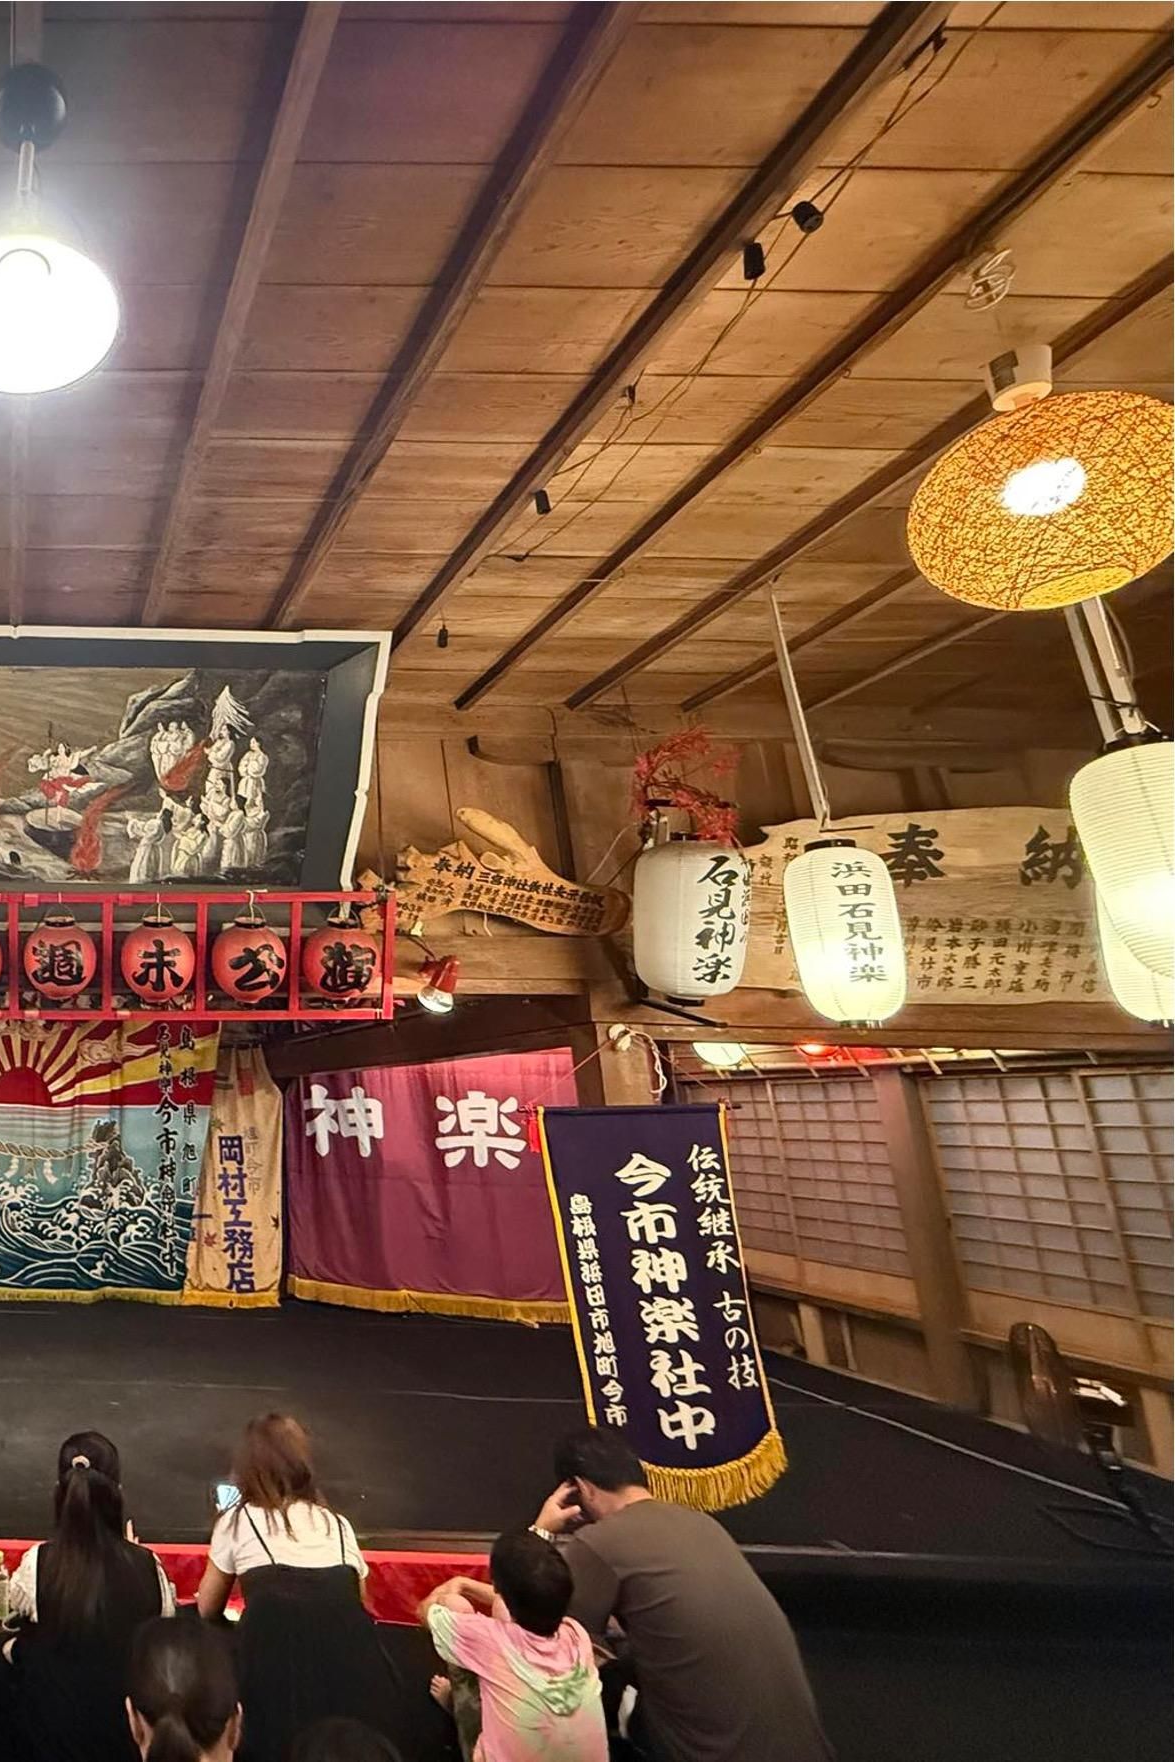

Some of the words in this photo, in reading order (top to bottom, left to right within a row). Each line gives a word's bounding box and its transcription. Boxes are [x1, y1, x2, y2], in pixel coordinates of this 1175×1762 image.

[692, 855, 740, 984] 石見神楽
[880, 822, 1082, 890] 奉納
[830, 861, 888, 983] 浜田石見神楽
[303, 1083, 528, 1171] 神楽
[218, 1134, 257, 1294] 岡村工務店
[686, 1143, 741, 1275] 伝統継承
[569, 1192, 628, 1427] 島根県浜田市旭町今市
[614, 1152, 717, 1451] 今市神楽社中
[713, 1290, 759, 1391] 古の技
